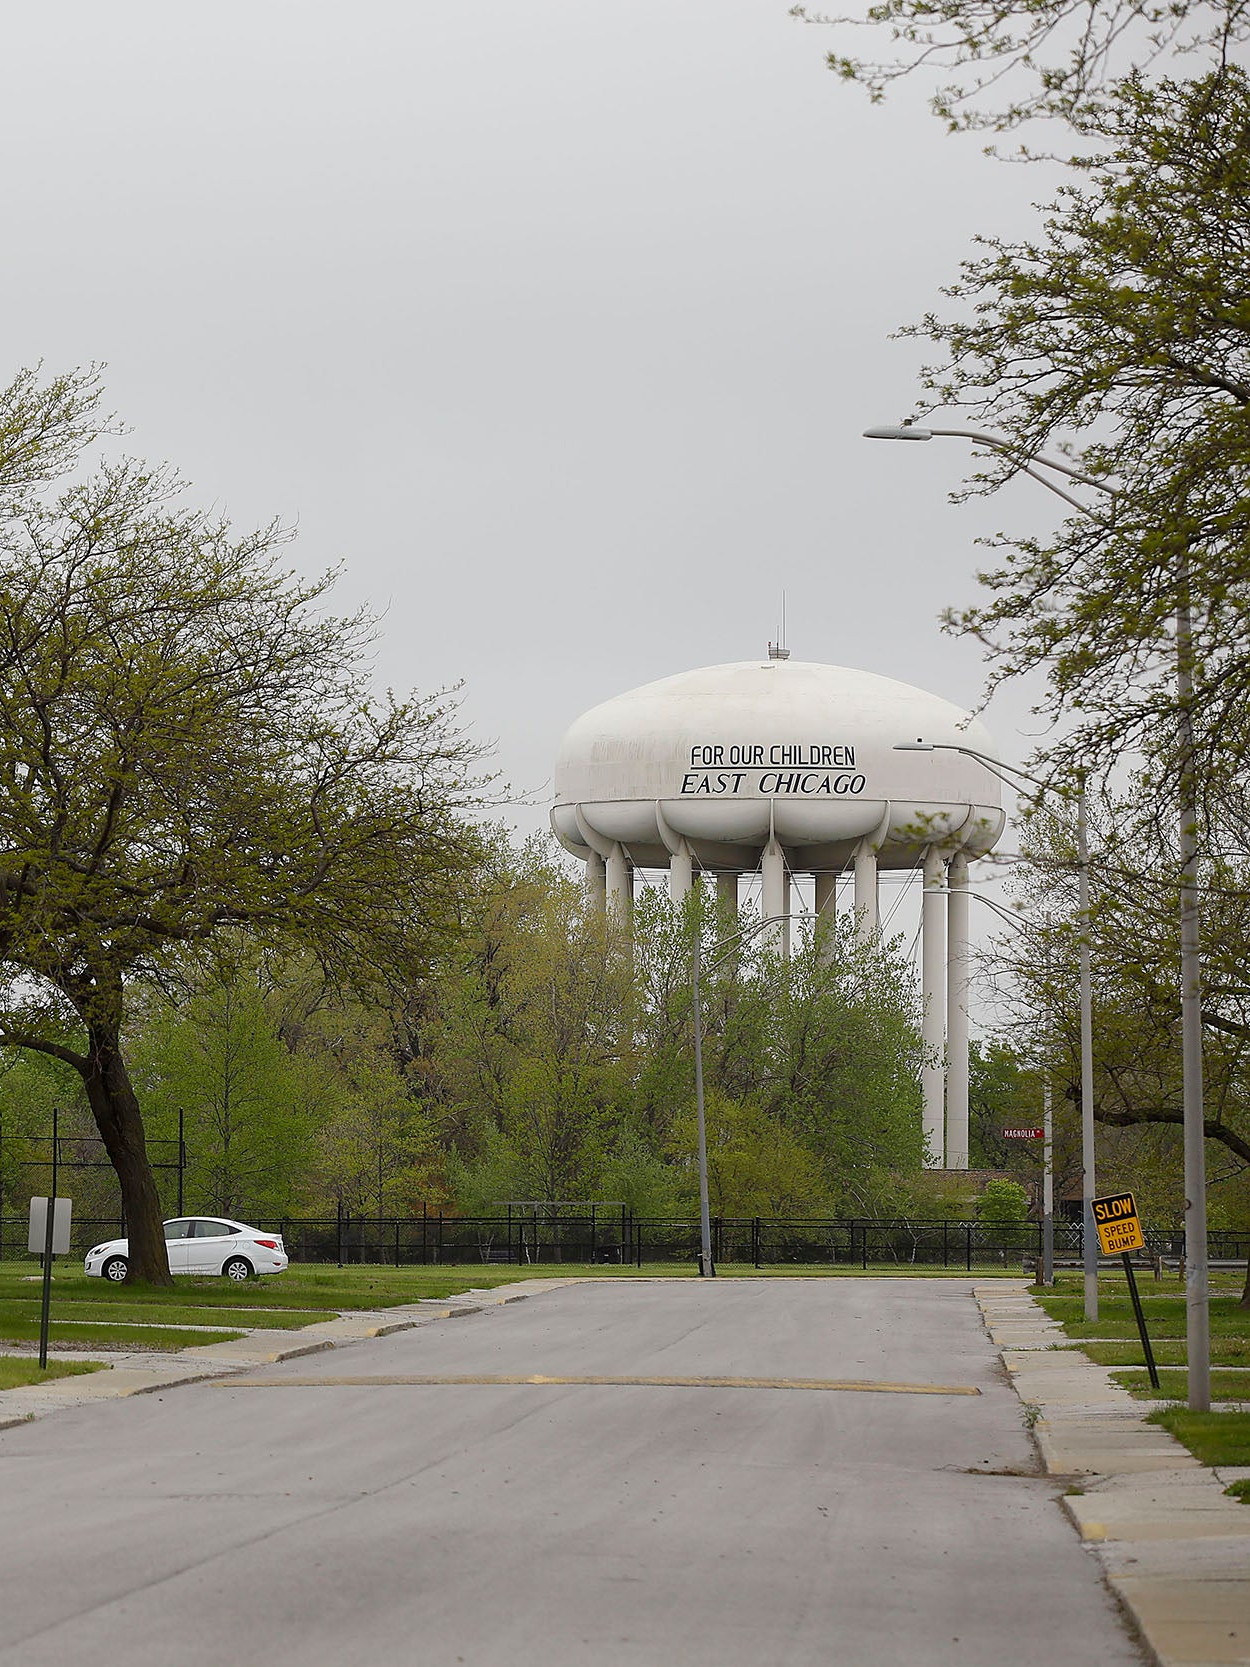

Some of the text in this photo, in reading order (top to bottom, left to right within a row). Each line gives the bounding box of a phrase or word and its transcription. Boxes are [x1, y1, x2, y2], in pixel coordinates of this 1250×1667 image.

[691, 745, 856, 766] FOR OUR CHILDREN
[680, 773, 867, 795] EAST CHICAGO
[1004, 1129, 1036, 1138] MAGNOLIA
[1095, 1197, 1132, 1220] SLOW
[1104, 1222, 1135, 1238] SPEED
[1108, 1235, 1136, 1251] BUMP
